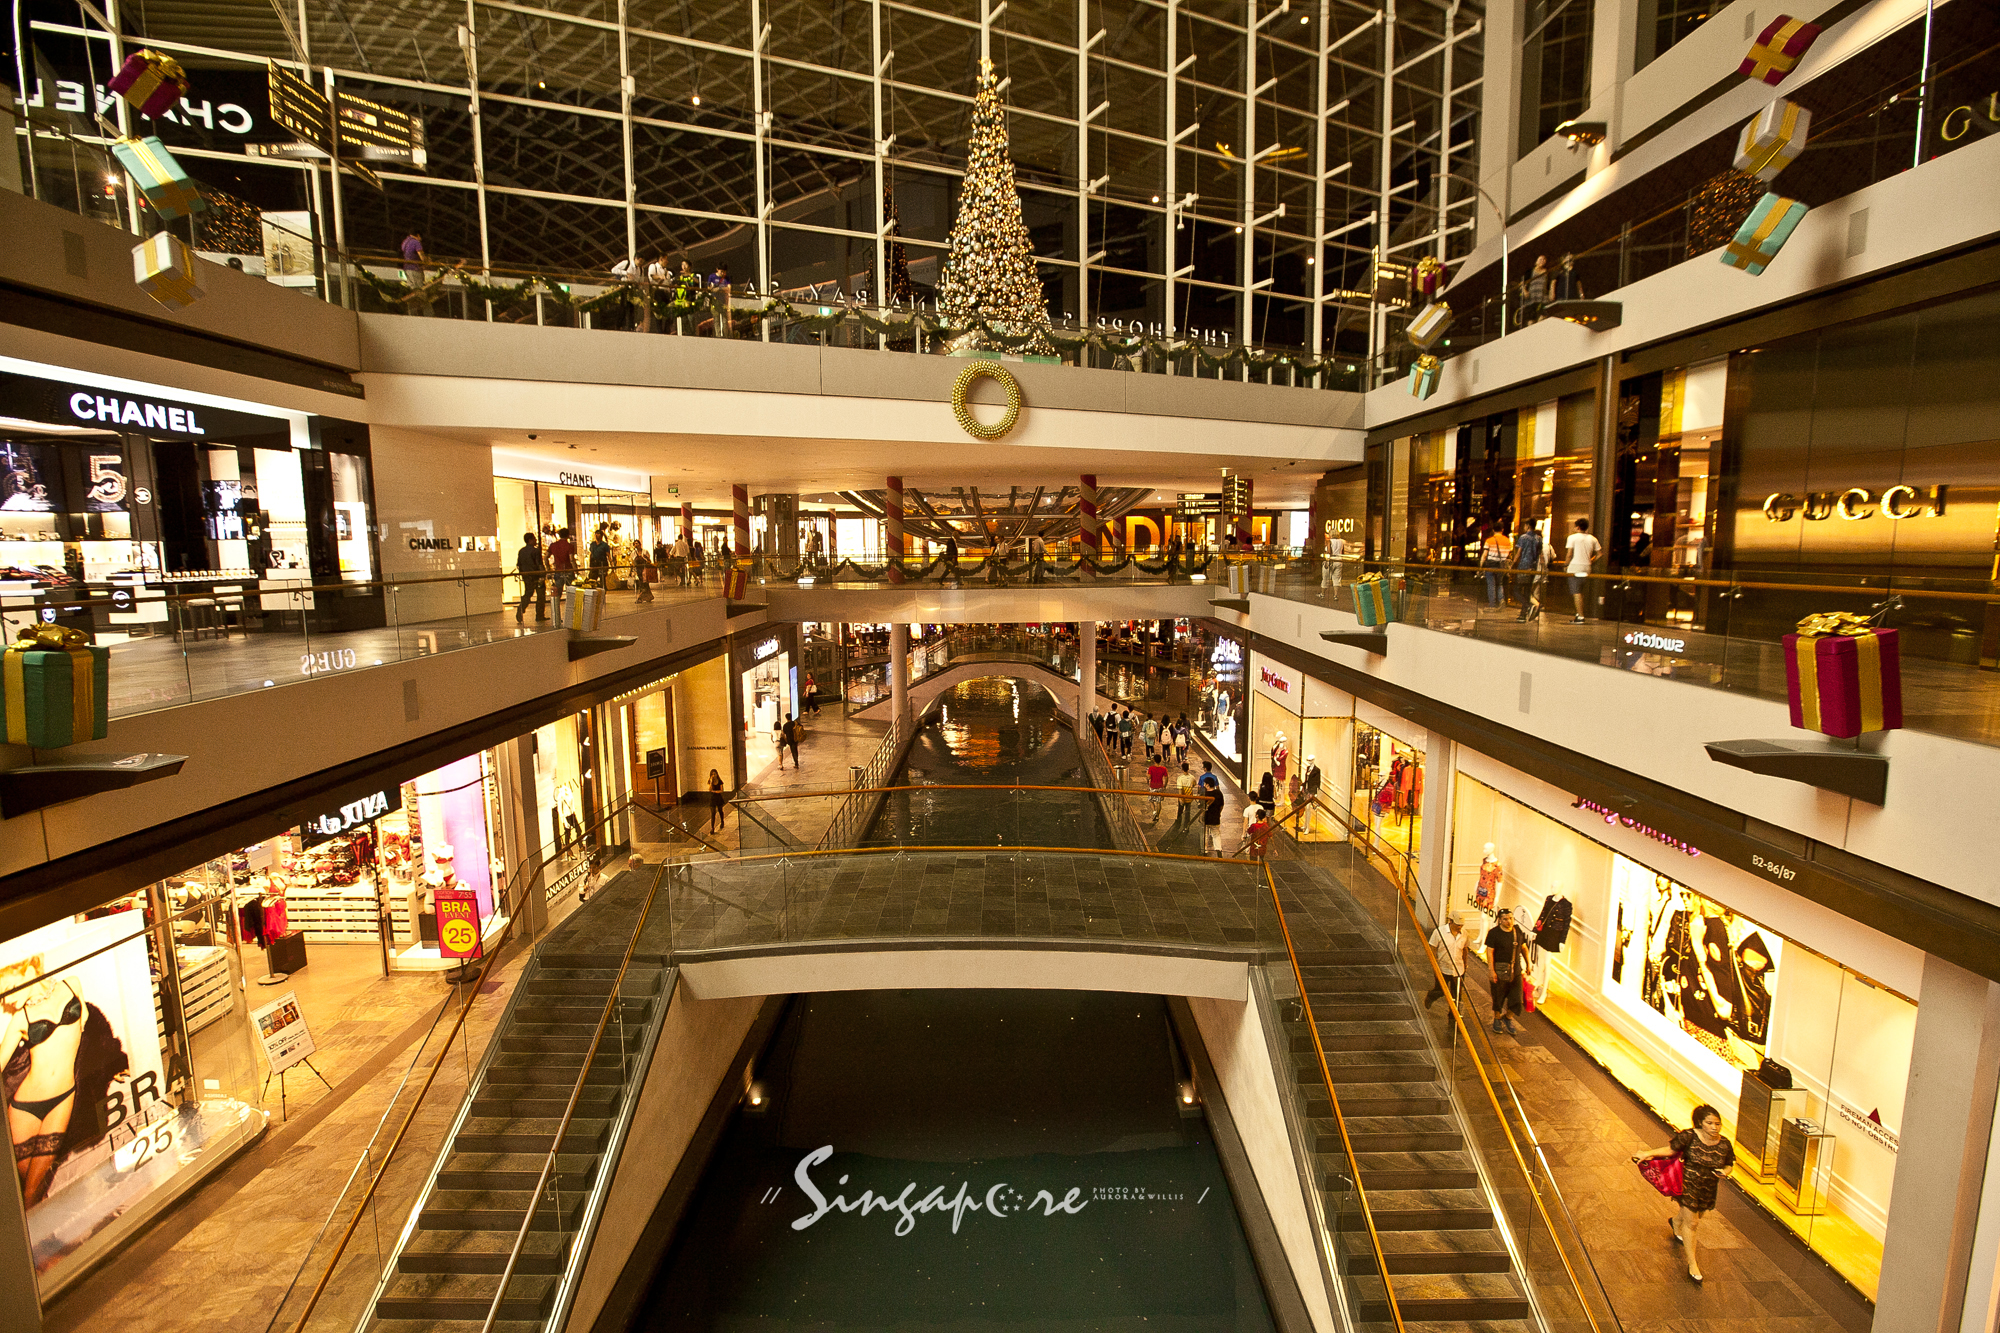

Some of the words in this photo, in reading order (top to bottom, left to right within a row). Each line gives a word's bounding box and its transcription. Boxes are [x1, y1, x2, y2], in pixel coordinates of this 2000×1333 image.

[70, 392, 205, 434] CHANEL
[559, 471, 596, 488] CHANEL
[1763, 484, 1950, 523] GUCCI
[1325, 518, 1354, 533] GUCCI
[409, 538, 453, 550] CHANEL
[1752, 854, 1797, 881] B2-86/87
[441, 901, 471, 913] BRA
[444, 911, 470, 919] EVENT
[1466, 893, 1499, 923] Holiday
[95, 1052, 193, 1136] BRA
[1839, 1111, 1851, 1122] DO
[1851, 1119, 1867, 1132] NOT
[1840, 1103, 1872, 1129] FIREMAN
